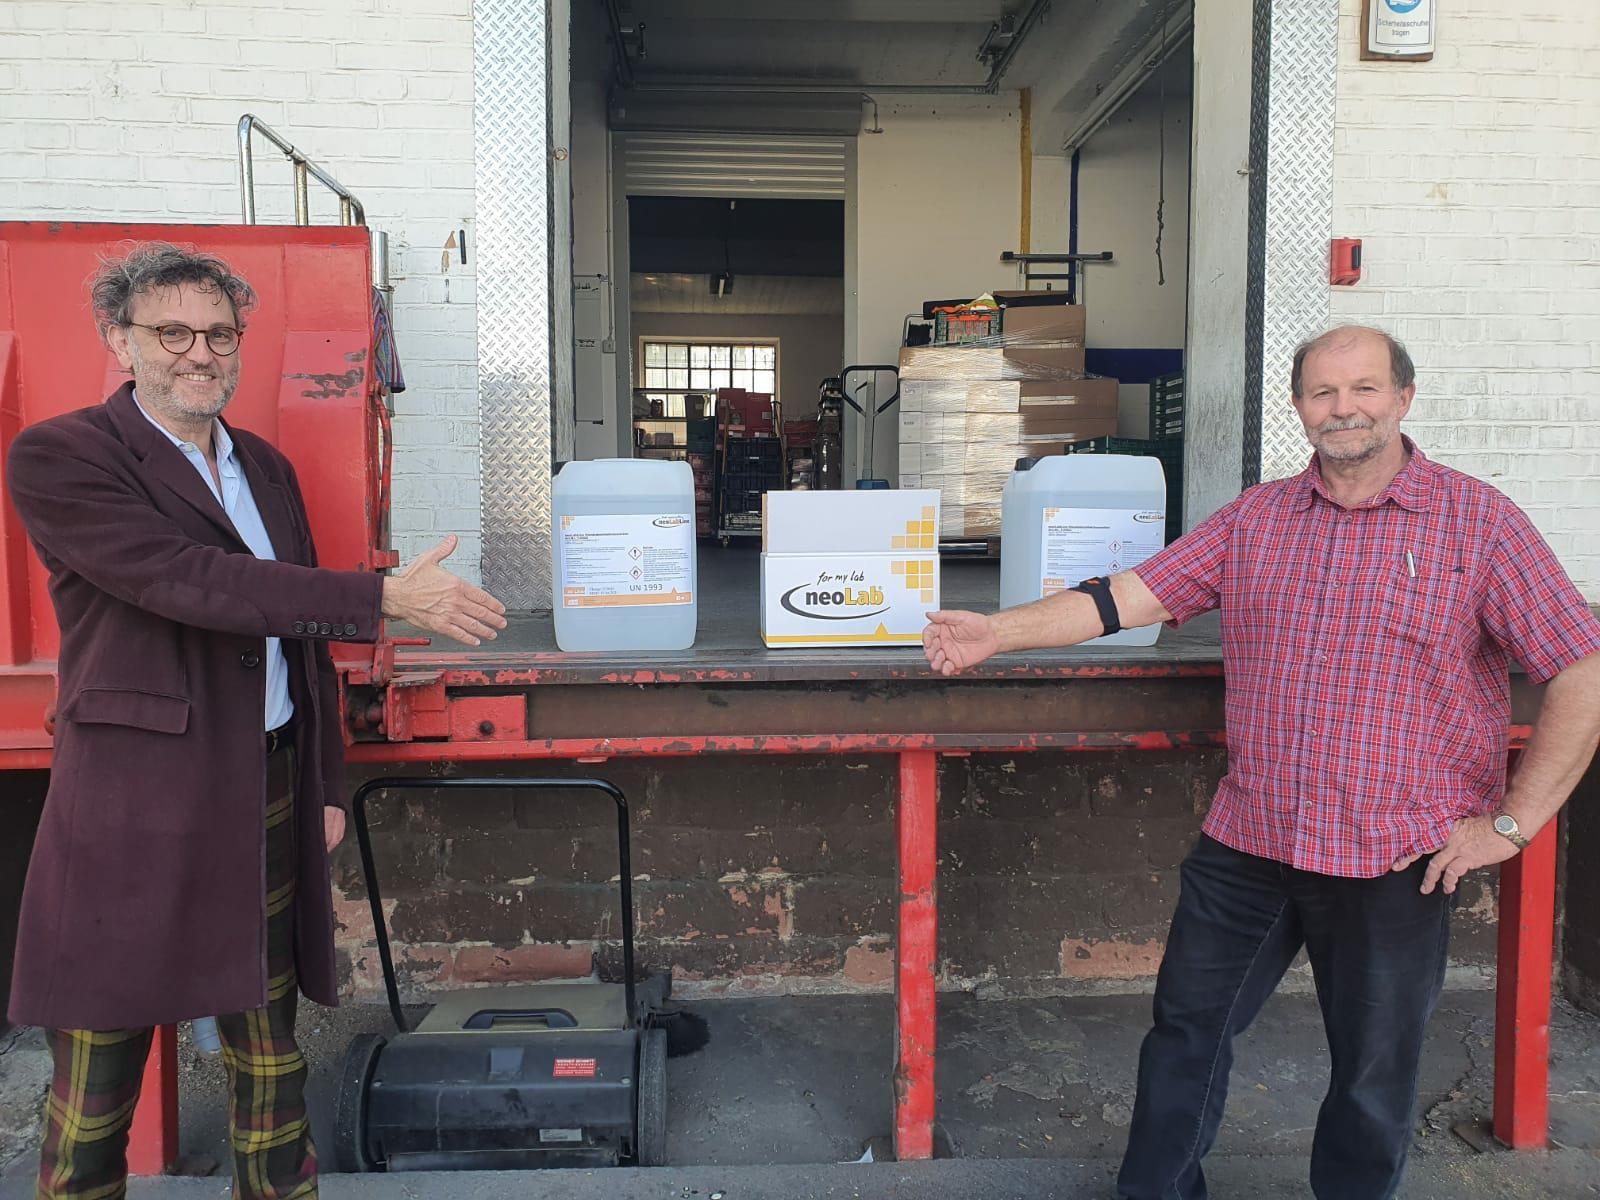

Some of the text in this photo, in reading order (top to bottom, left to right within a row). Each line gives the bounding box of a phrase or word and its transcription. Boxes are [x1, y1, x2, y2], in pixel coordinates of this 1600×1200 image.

[817, 570, 865, 585] for my lab
[629, 583, 663, 592] UN 1993
